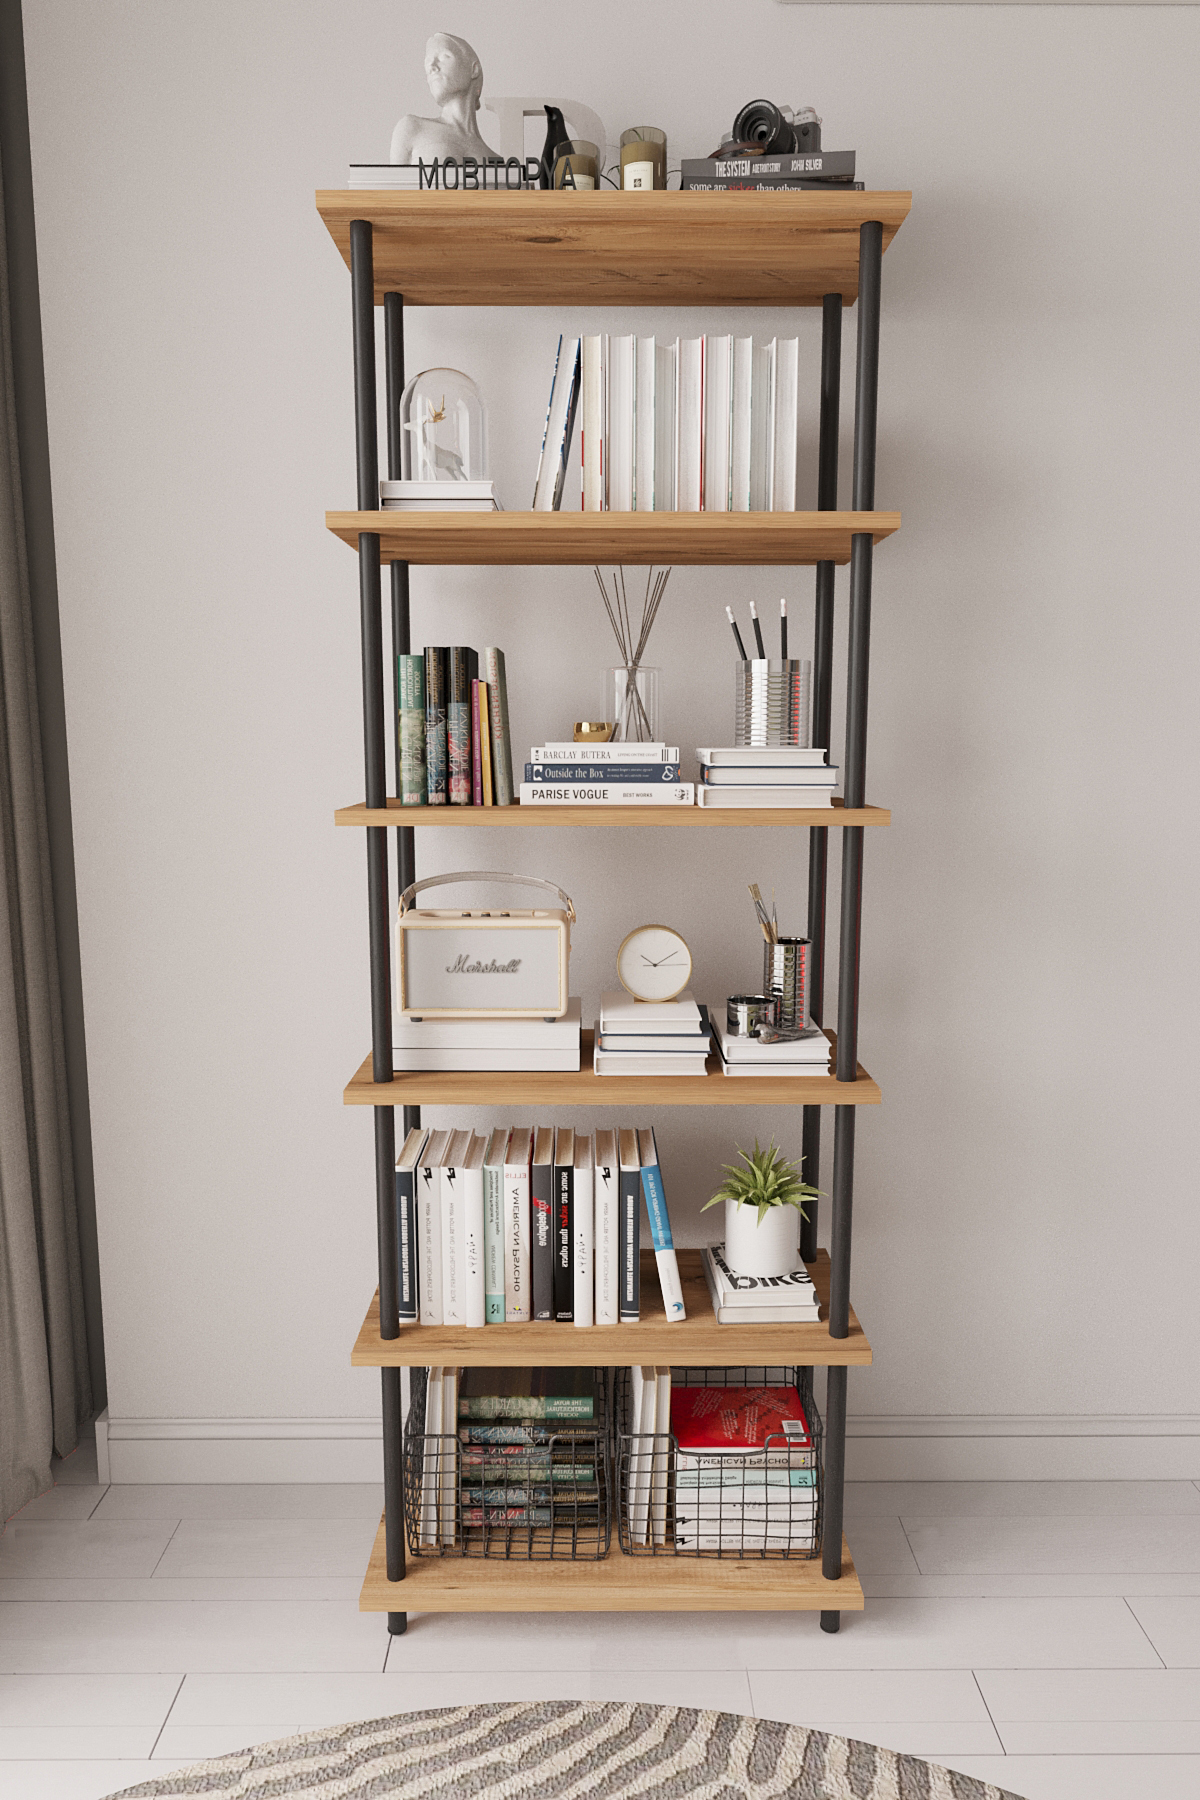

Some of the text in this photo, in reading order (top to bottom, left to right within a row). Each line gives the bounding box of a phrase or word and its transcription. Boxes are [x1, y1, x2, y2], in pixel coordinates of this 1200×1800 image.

[418, 156, 577, 190] MOBITOPYA
[715, 162, 726, 177] THE
[726, 160, 751, 177] SYSTEM
[805, 159, 823, 170] SILVER
[543, 751, 577, 759] BARCLAY
[581, 751, 611, 759] BUTERA
[545, 767, 604, 778] Outside the Box
[532, 789, 609, 799] PARISE VOGUE
[445, 953, 523, 974] Marshall
